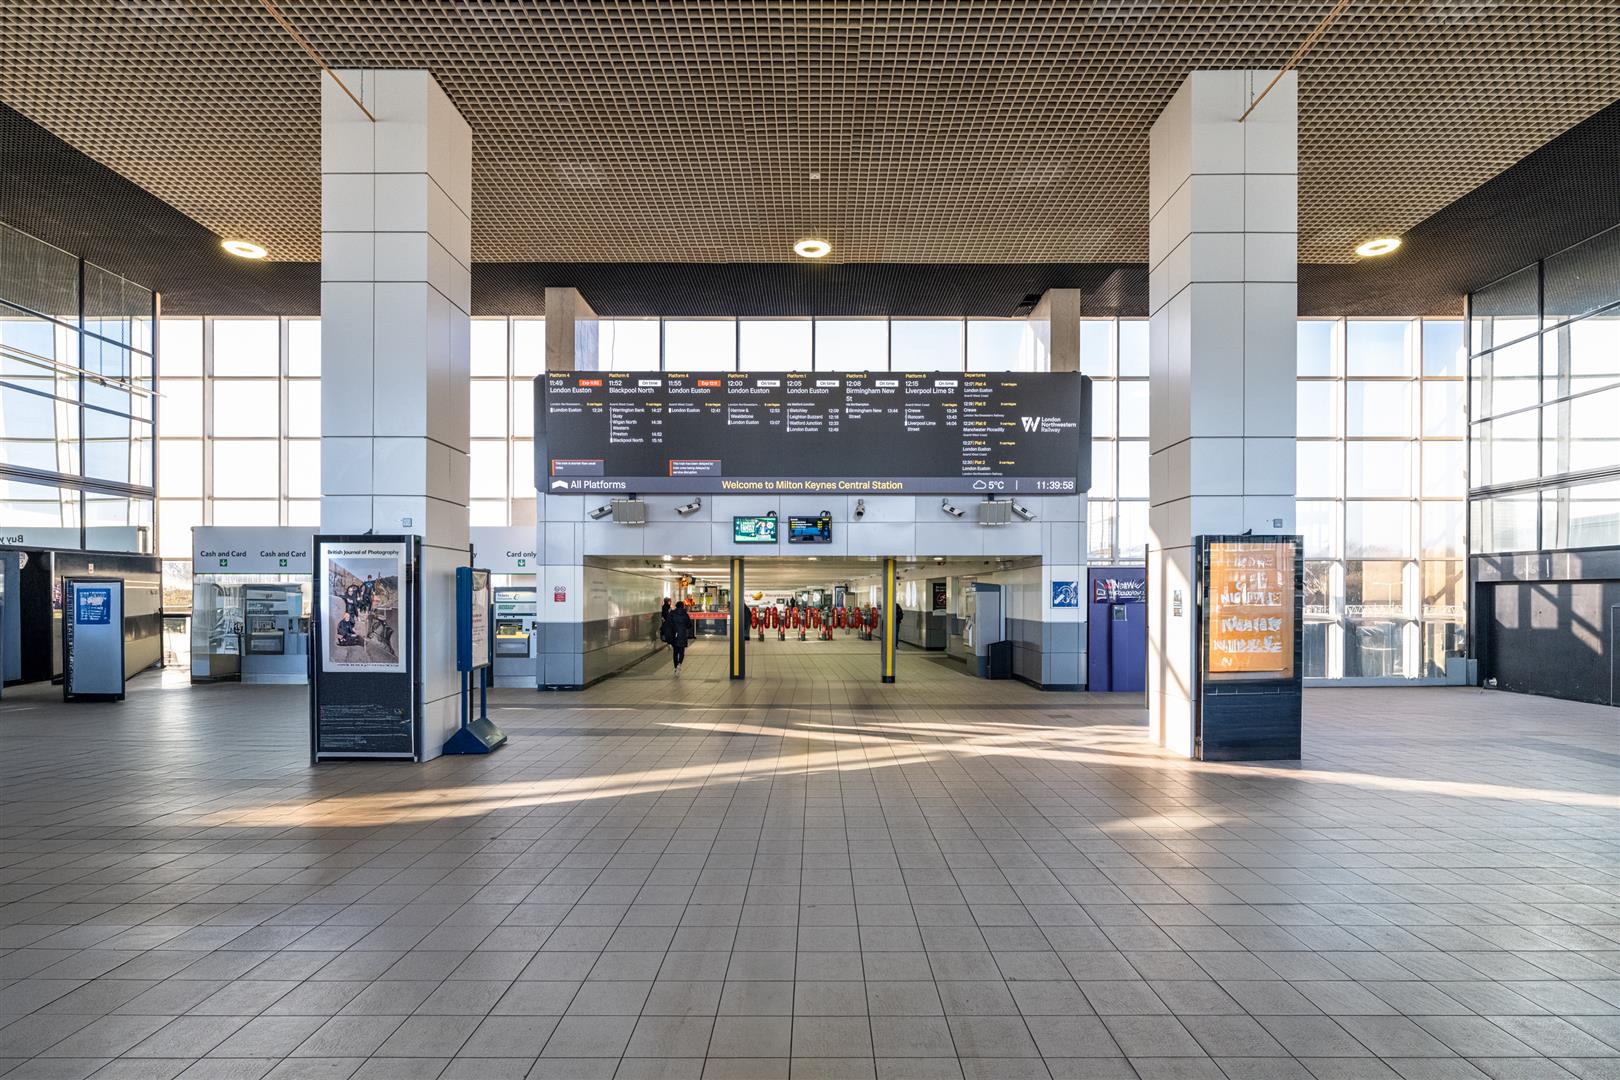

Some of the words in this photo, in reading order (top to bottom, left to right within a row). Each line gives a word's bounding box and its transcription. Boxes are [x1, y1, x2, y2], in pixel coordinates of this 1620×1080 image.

[571, 480, 581, 488] All
[584, 480, 626, 489] Platforms
[722, 481, 762, 489] Welcome
[776, 481, 802, 489] Milton
[805, 482, 836, 490] Keynes
[838, 481, 870, 489] Central
[872, 481, 903, 489] Station
[1037, 481, 1074, 490] 11:39:58
